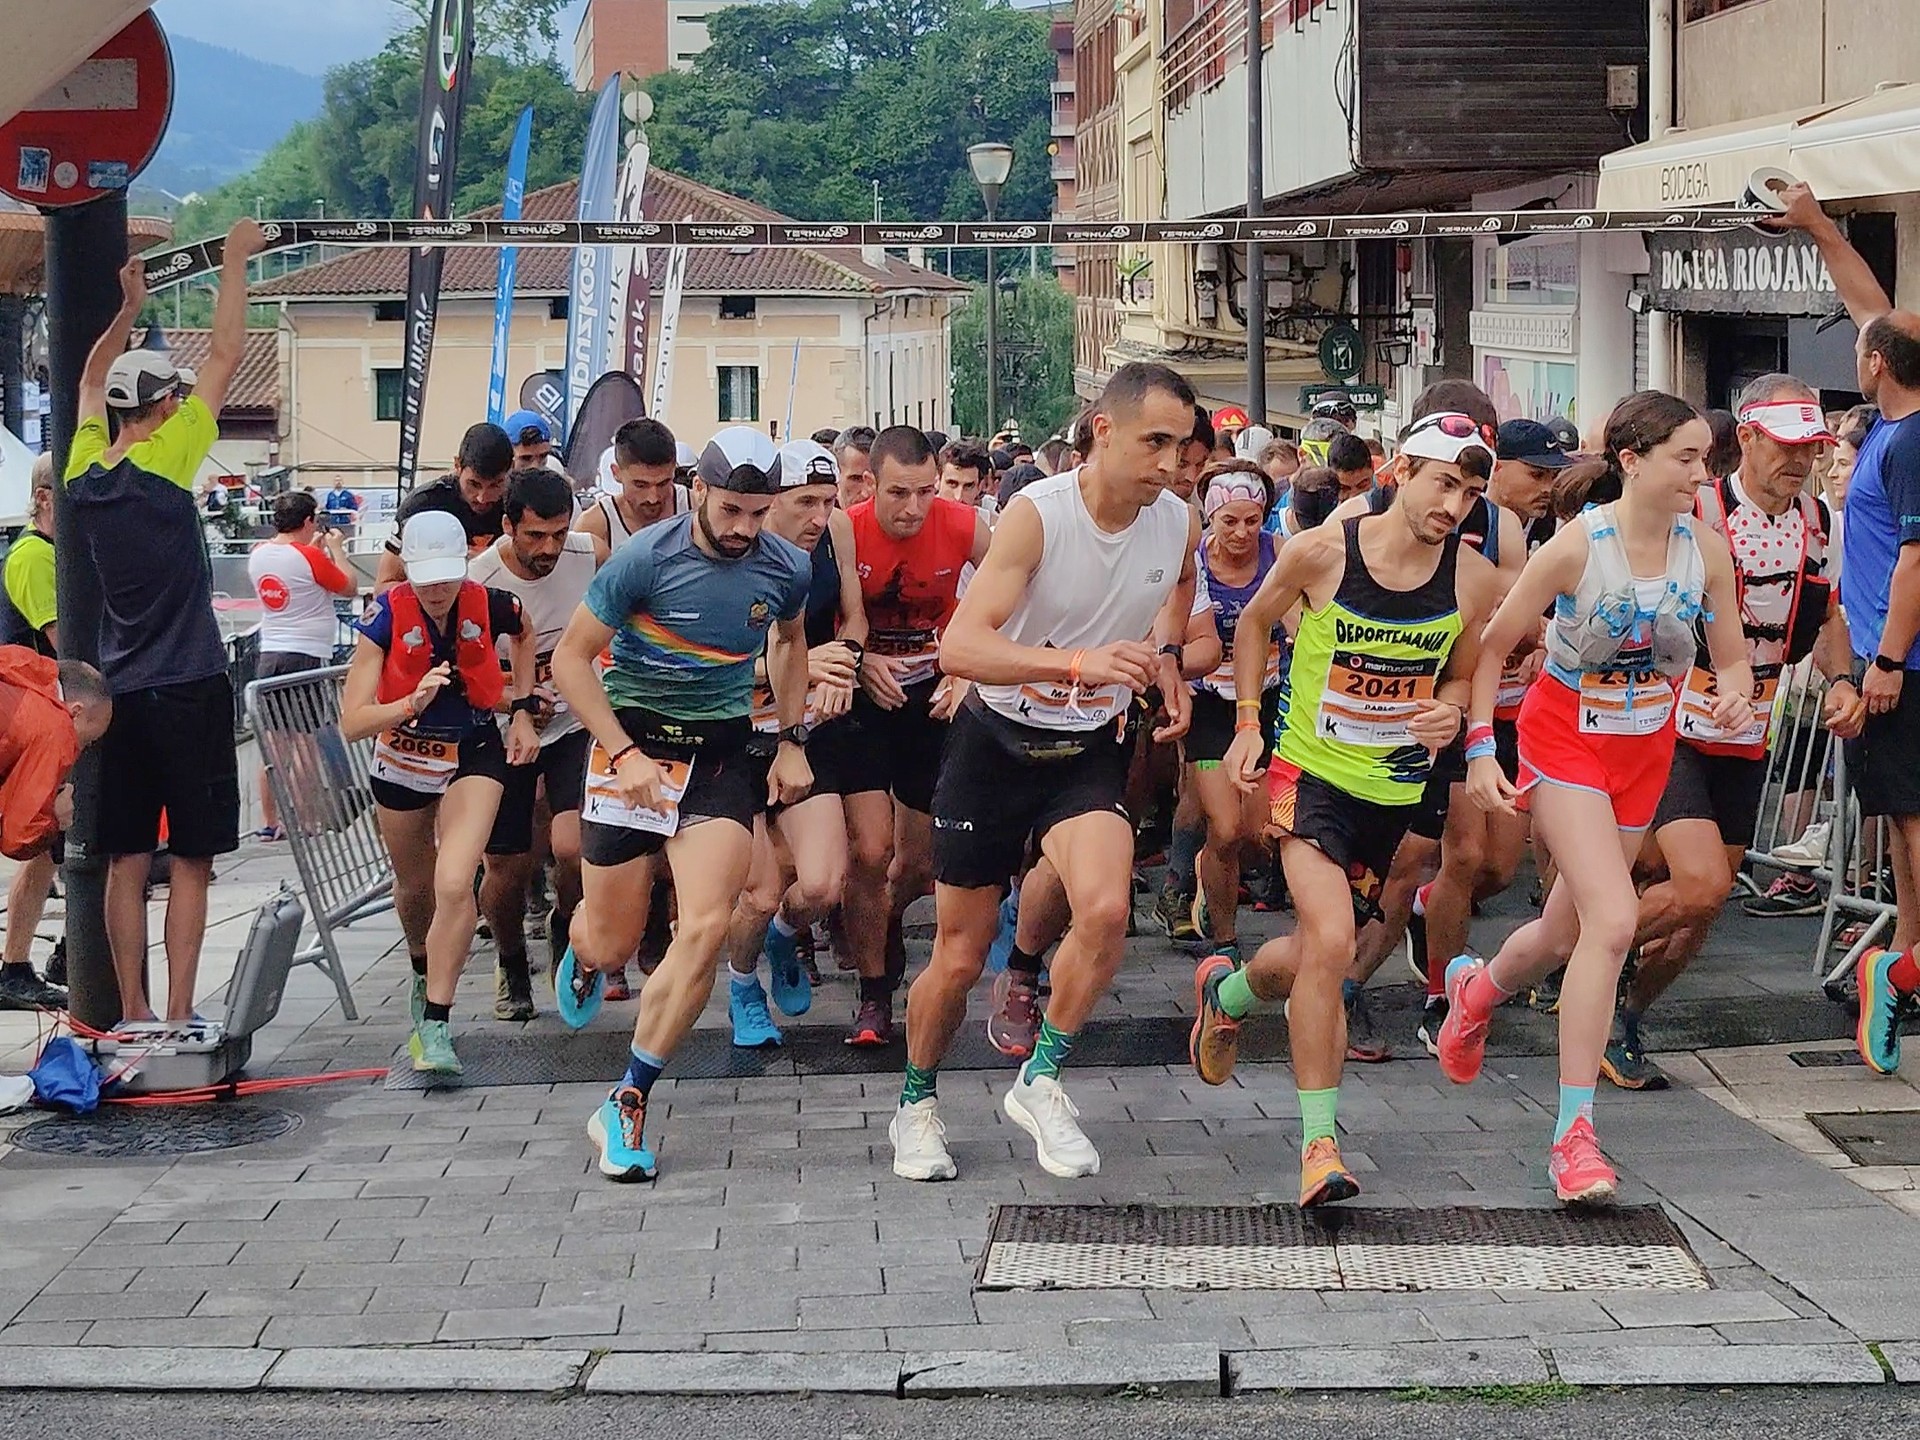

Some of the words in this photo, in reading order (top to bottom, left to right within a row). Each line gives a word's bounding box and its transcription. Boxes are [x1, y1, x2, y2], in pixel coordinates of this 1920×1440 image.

[1661, 162, 1710, 201] BODEGA
[406, 226, 456, 235] TERNUA
[501, 225, 551, 235] TERNUA
[595, 226, 645, 236] TERNUA
[690, 227, 740, 236] TERNUA
[784, 228, 833, 237] TERNUA
[878, 229, 928, 238] TERNUA
[971, 230, 1021, 239] TERNUA
[1066, 230, 1115, 239] TERNUA
[1159, 229, 1208, 238] TERNUA
[1252, 228, 1301, 237] TERNUA
[1345, 227, 1394, 235] TERNUA
[1733, 244, 1836, 293] RIOJANA
[1336, 618, 1450, 653] DEPORTEMANIA
[1345, 673, 1417, 699] 2041
[1364, 704, 1396, 712] PABLO
[388, 727, 446, 758] 2069
